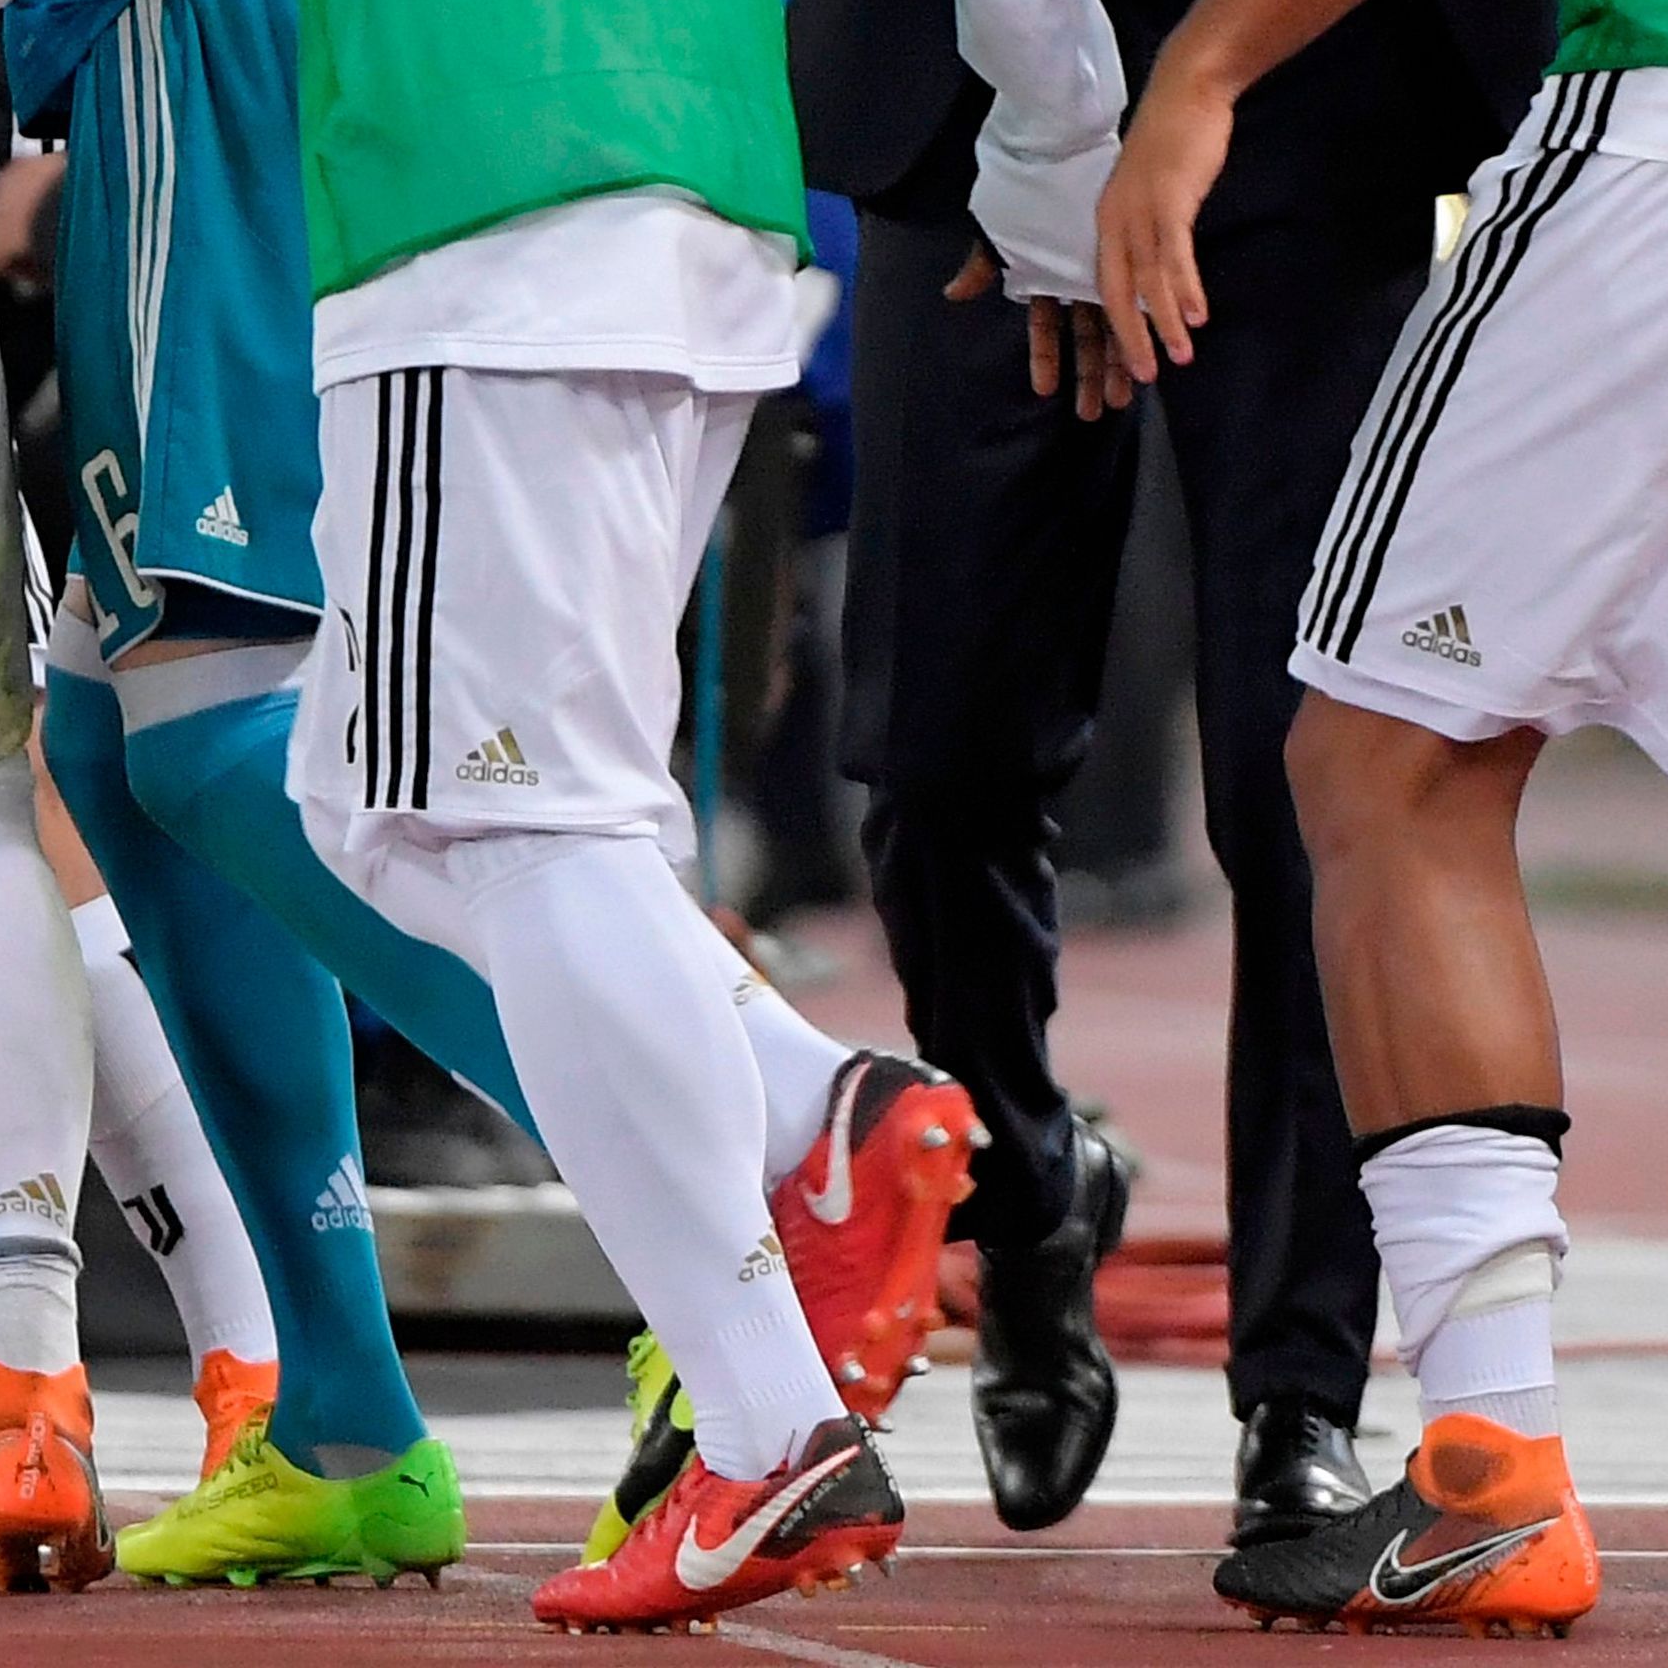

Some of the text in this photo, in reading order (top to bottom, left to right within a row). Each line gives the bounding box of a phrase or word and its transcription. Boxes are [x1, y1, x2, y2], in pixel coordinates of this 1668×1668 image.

[1401, 627, 1482, 668] adidas
[456, 762, 540, 788] adidas
[311, 1205, 374, 1232] adida
